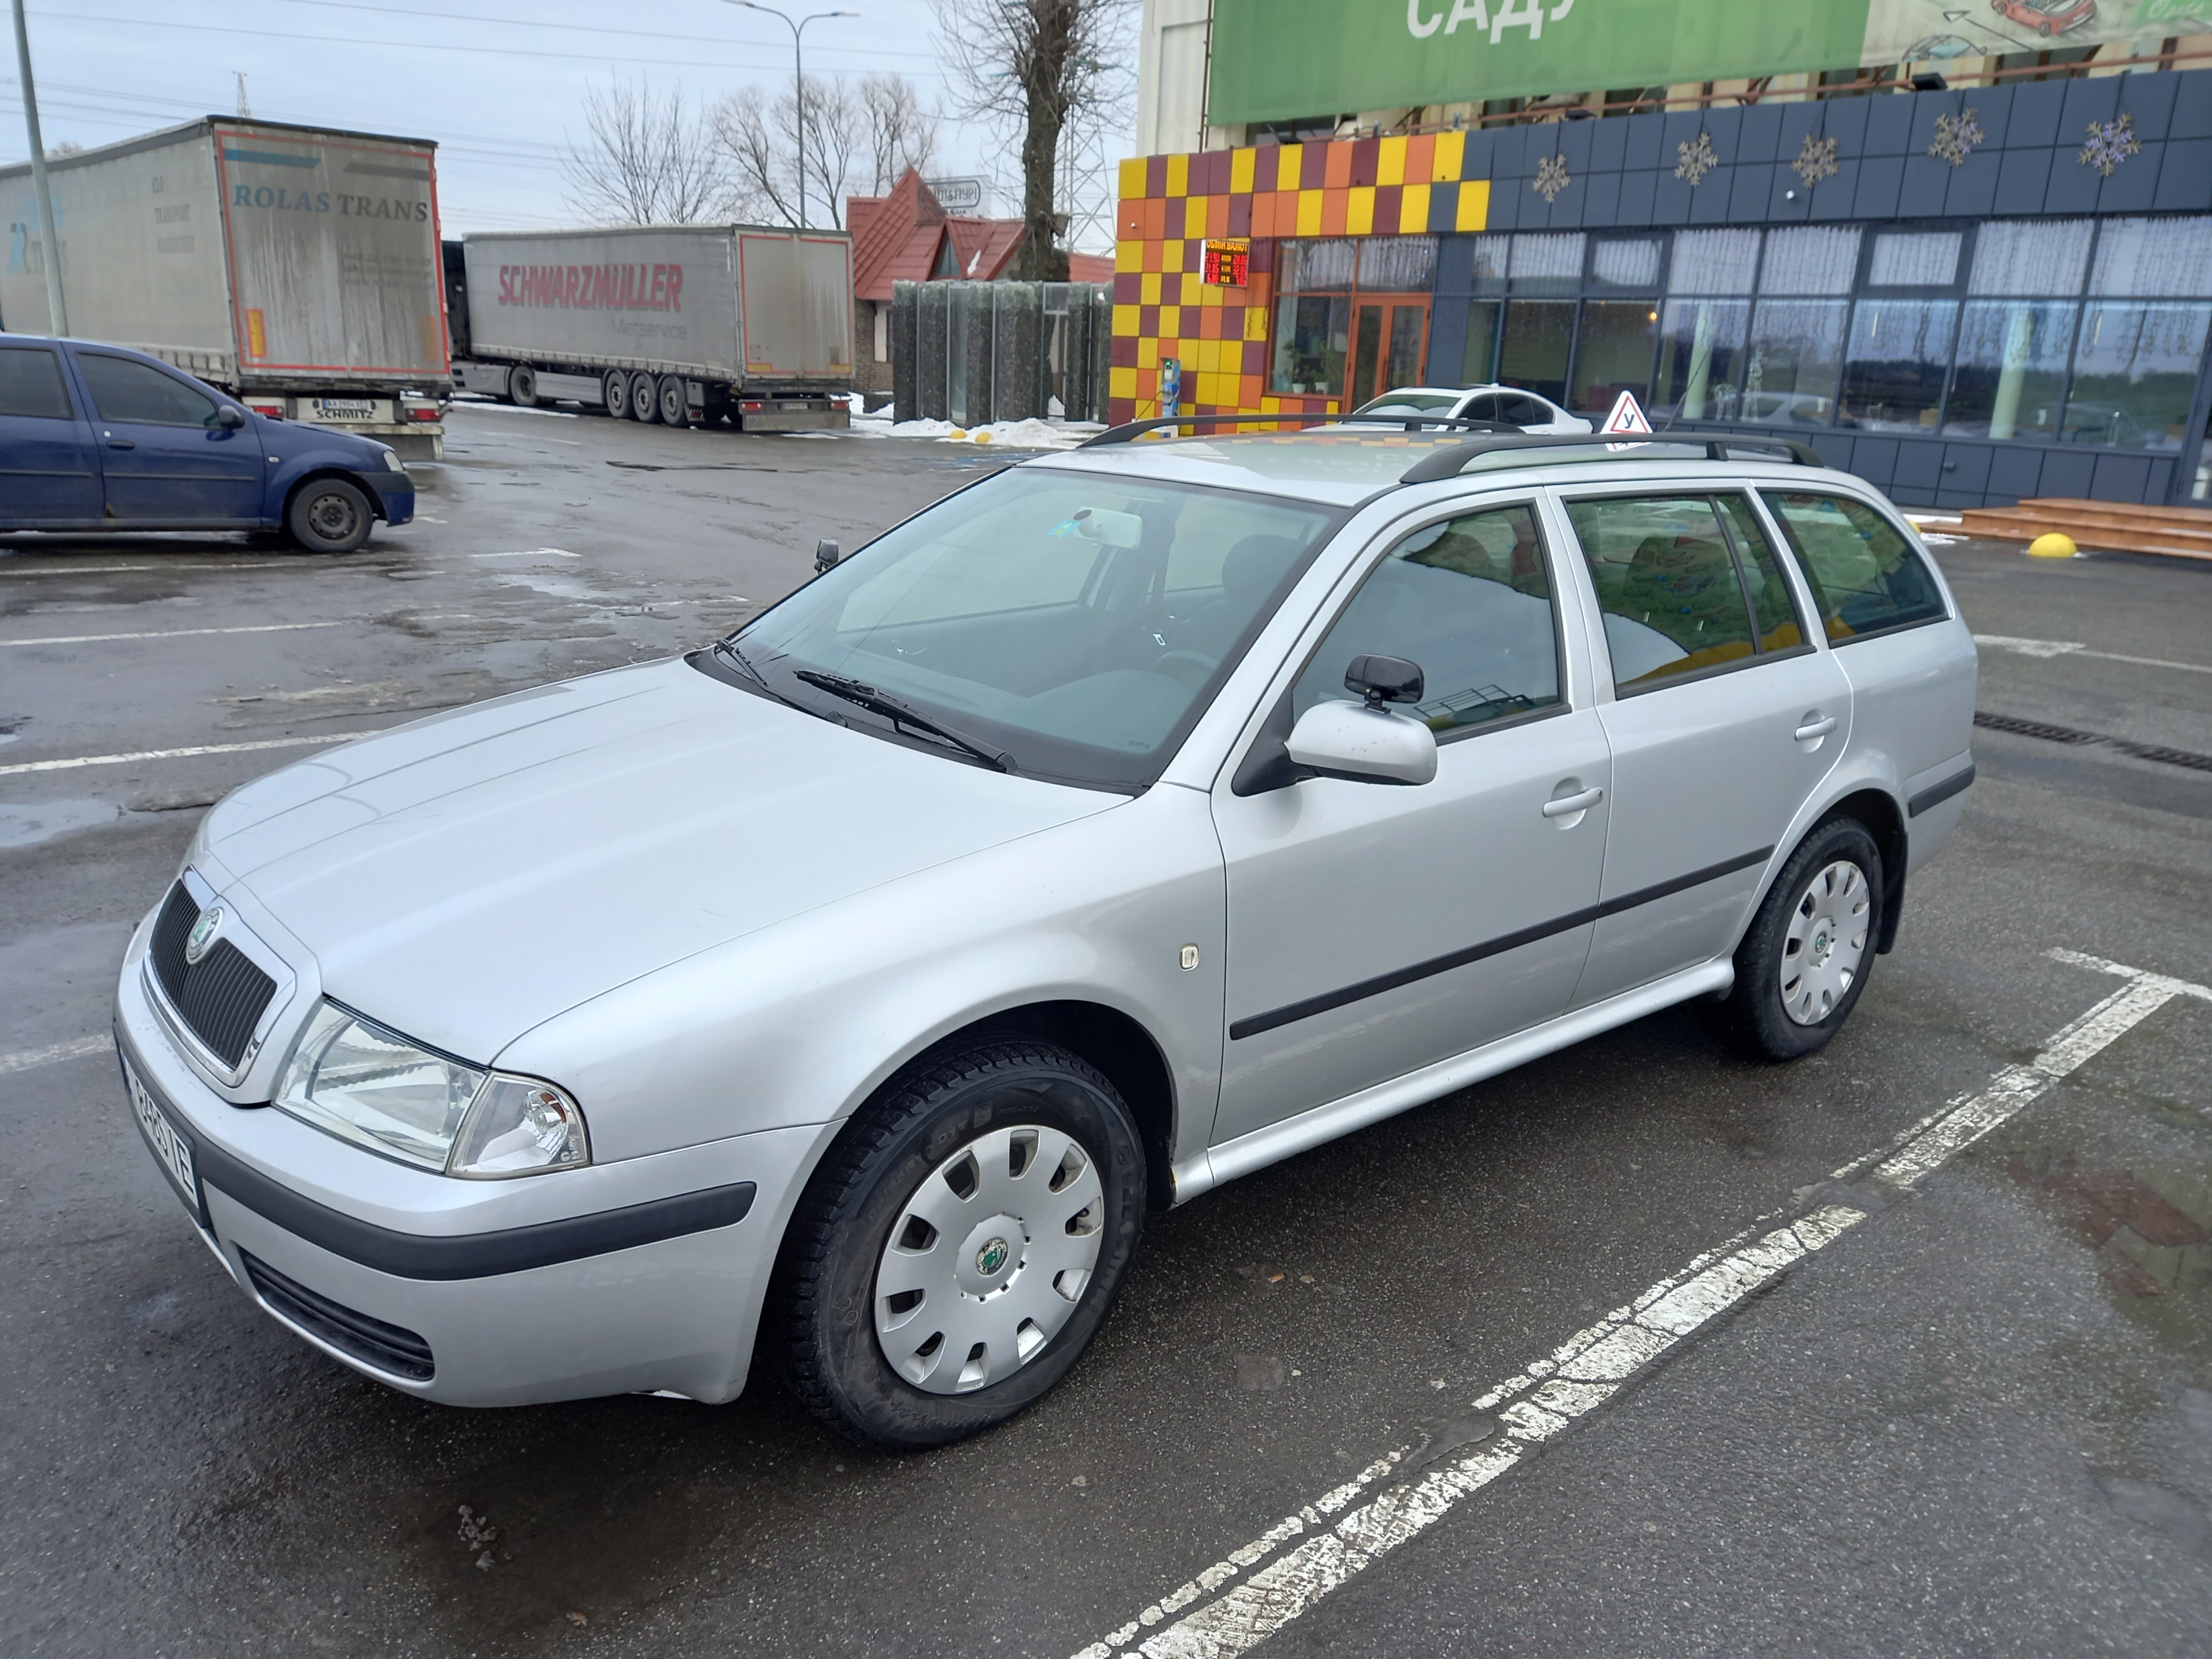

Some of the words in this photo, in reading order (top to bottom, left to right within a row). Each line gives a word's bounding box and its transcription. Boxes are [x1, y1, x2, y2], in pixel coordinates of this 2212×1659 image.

[234, 185, 330, 213] ROLAS
[337, 194, 427, 222] TRANS
[1207, 240, 1226, 250] ОБМІН
[1227, 242, 1247, 252] ВАЛЮТ
[499, 263, 684, 312] SCHWARZMÜLLER
[1220, 275, 1230, 283] PLN
[612, 317, 687, 340] Mietservice
[317, 409, 374, 419] SCHMITZ
[168, 1126, 195, 1196] IE
